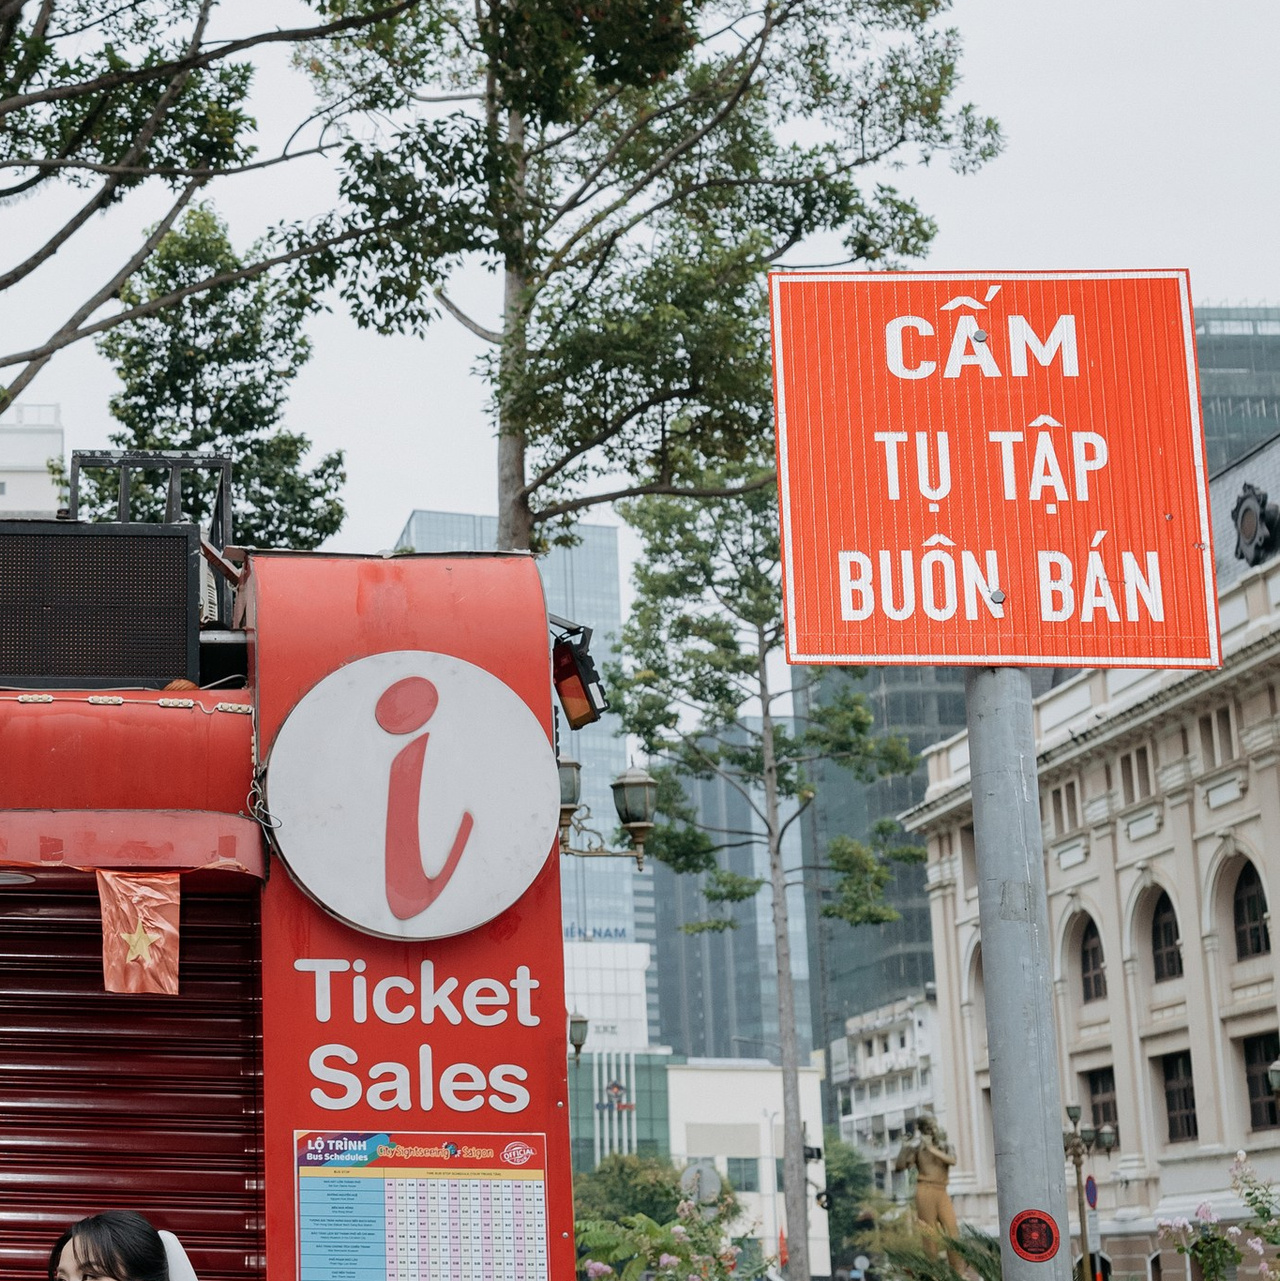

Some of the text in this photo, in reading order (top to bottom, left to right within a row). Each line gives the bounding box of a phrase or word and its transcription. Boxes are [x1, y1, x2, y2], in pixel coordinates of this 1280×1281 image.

[884, 284, 1081, 380] CẤM
[873, 413, 1109, 515] TỤ TẬP
[838, 529, 1165, 623] BUÔN BÁN
[374, 675, 474, 921] i
[591, 926, 627, 939] NAM
[293, 957, 541, 1027] Ticket
[308, 1043, 531, 1112] Sales
[306, 1152, 369, 1162] Bus Schedules
[307, 1136, 367, 1153] LỘ TRÌNH
[461, 1145, 495, 1160] Saigon
[502, 1148, 534, 1160] OFFICIAL
